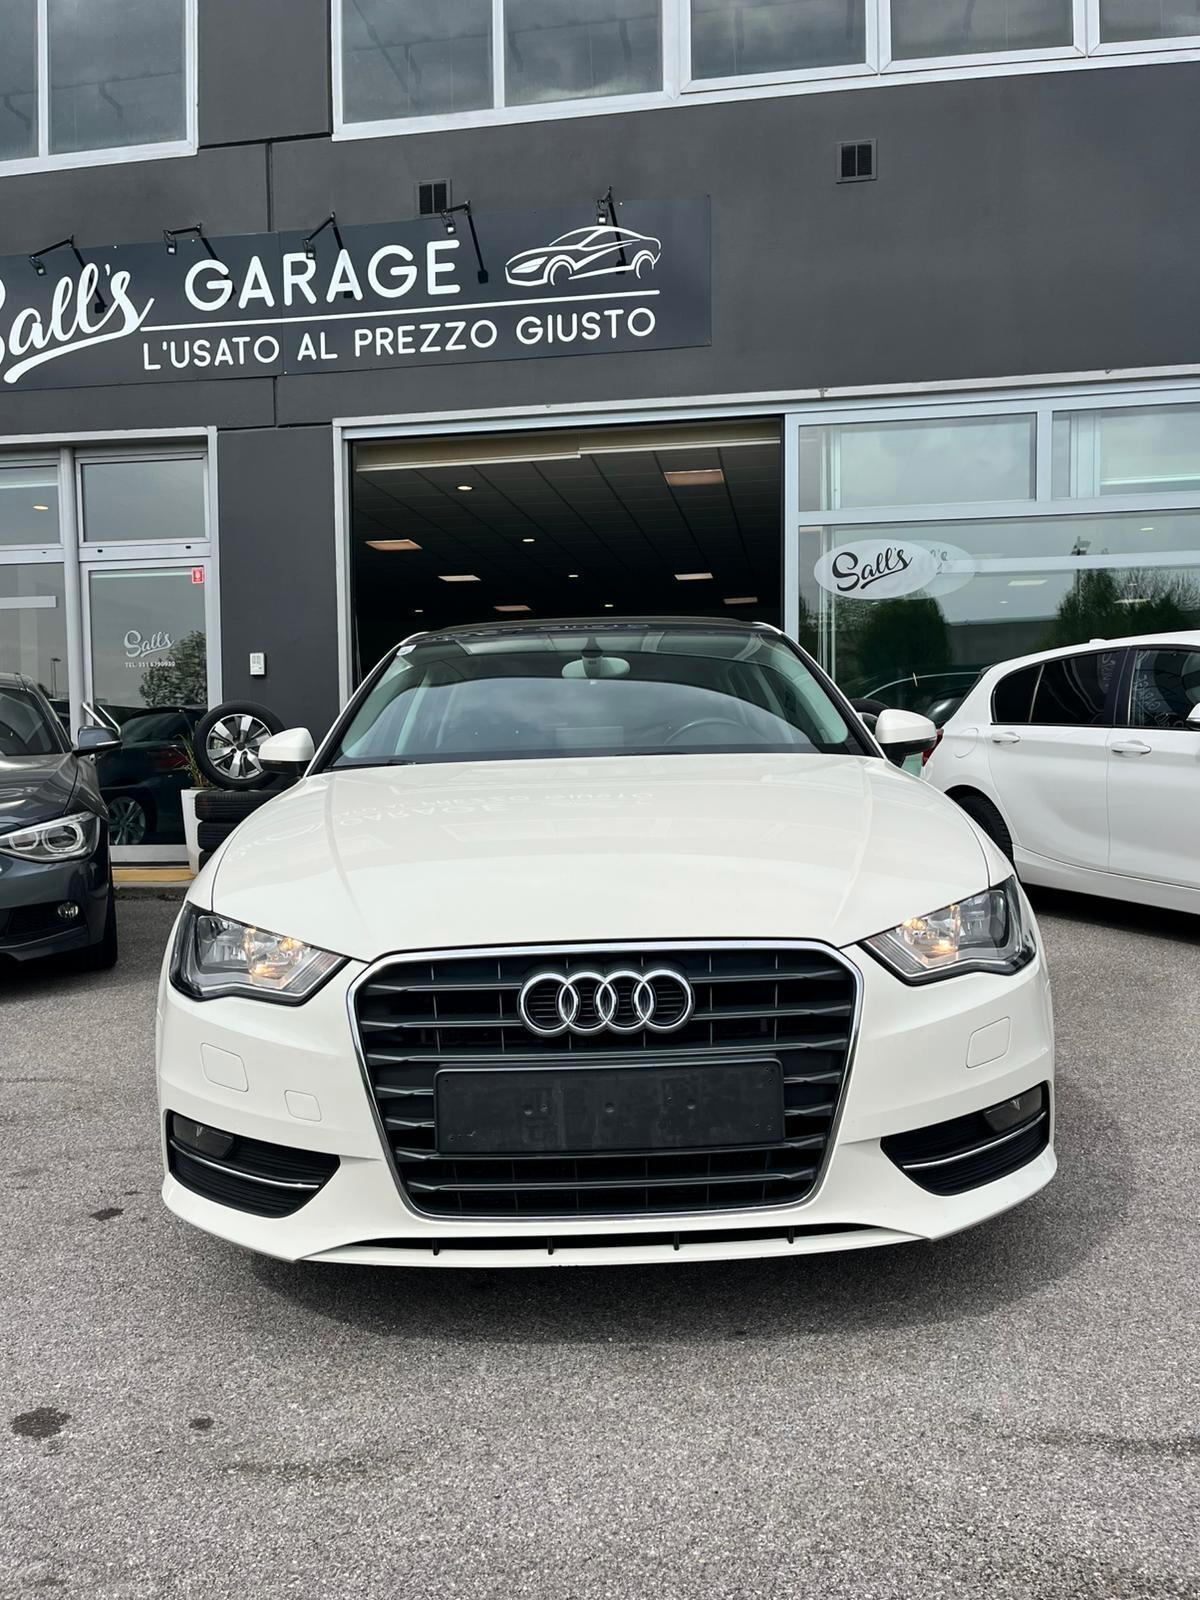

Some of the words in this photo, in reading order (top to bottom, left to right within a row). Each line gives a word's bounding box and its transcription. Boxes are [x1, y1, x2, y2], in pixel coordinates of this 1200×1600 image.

[0, 262, 155, 384] all's
[184, 239, 461, 312] GARAGE
[143, 335, 280, 371] L'USATO
[297, 331, 338, 361] AL
[354, 319, 498, 358] PREZZO
[515, 307, 656, 345] GIUSTO
[832, 547, 913, 592] Sall's
[123, 630, 175, 658] Sall's
